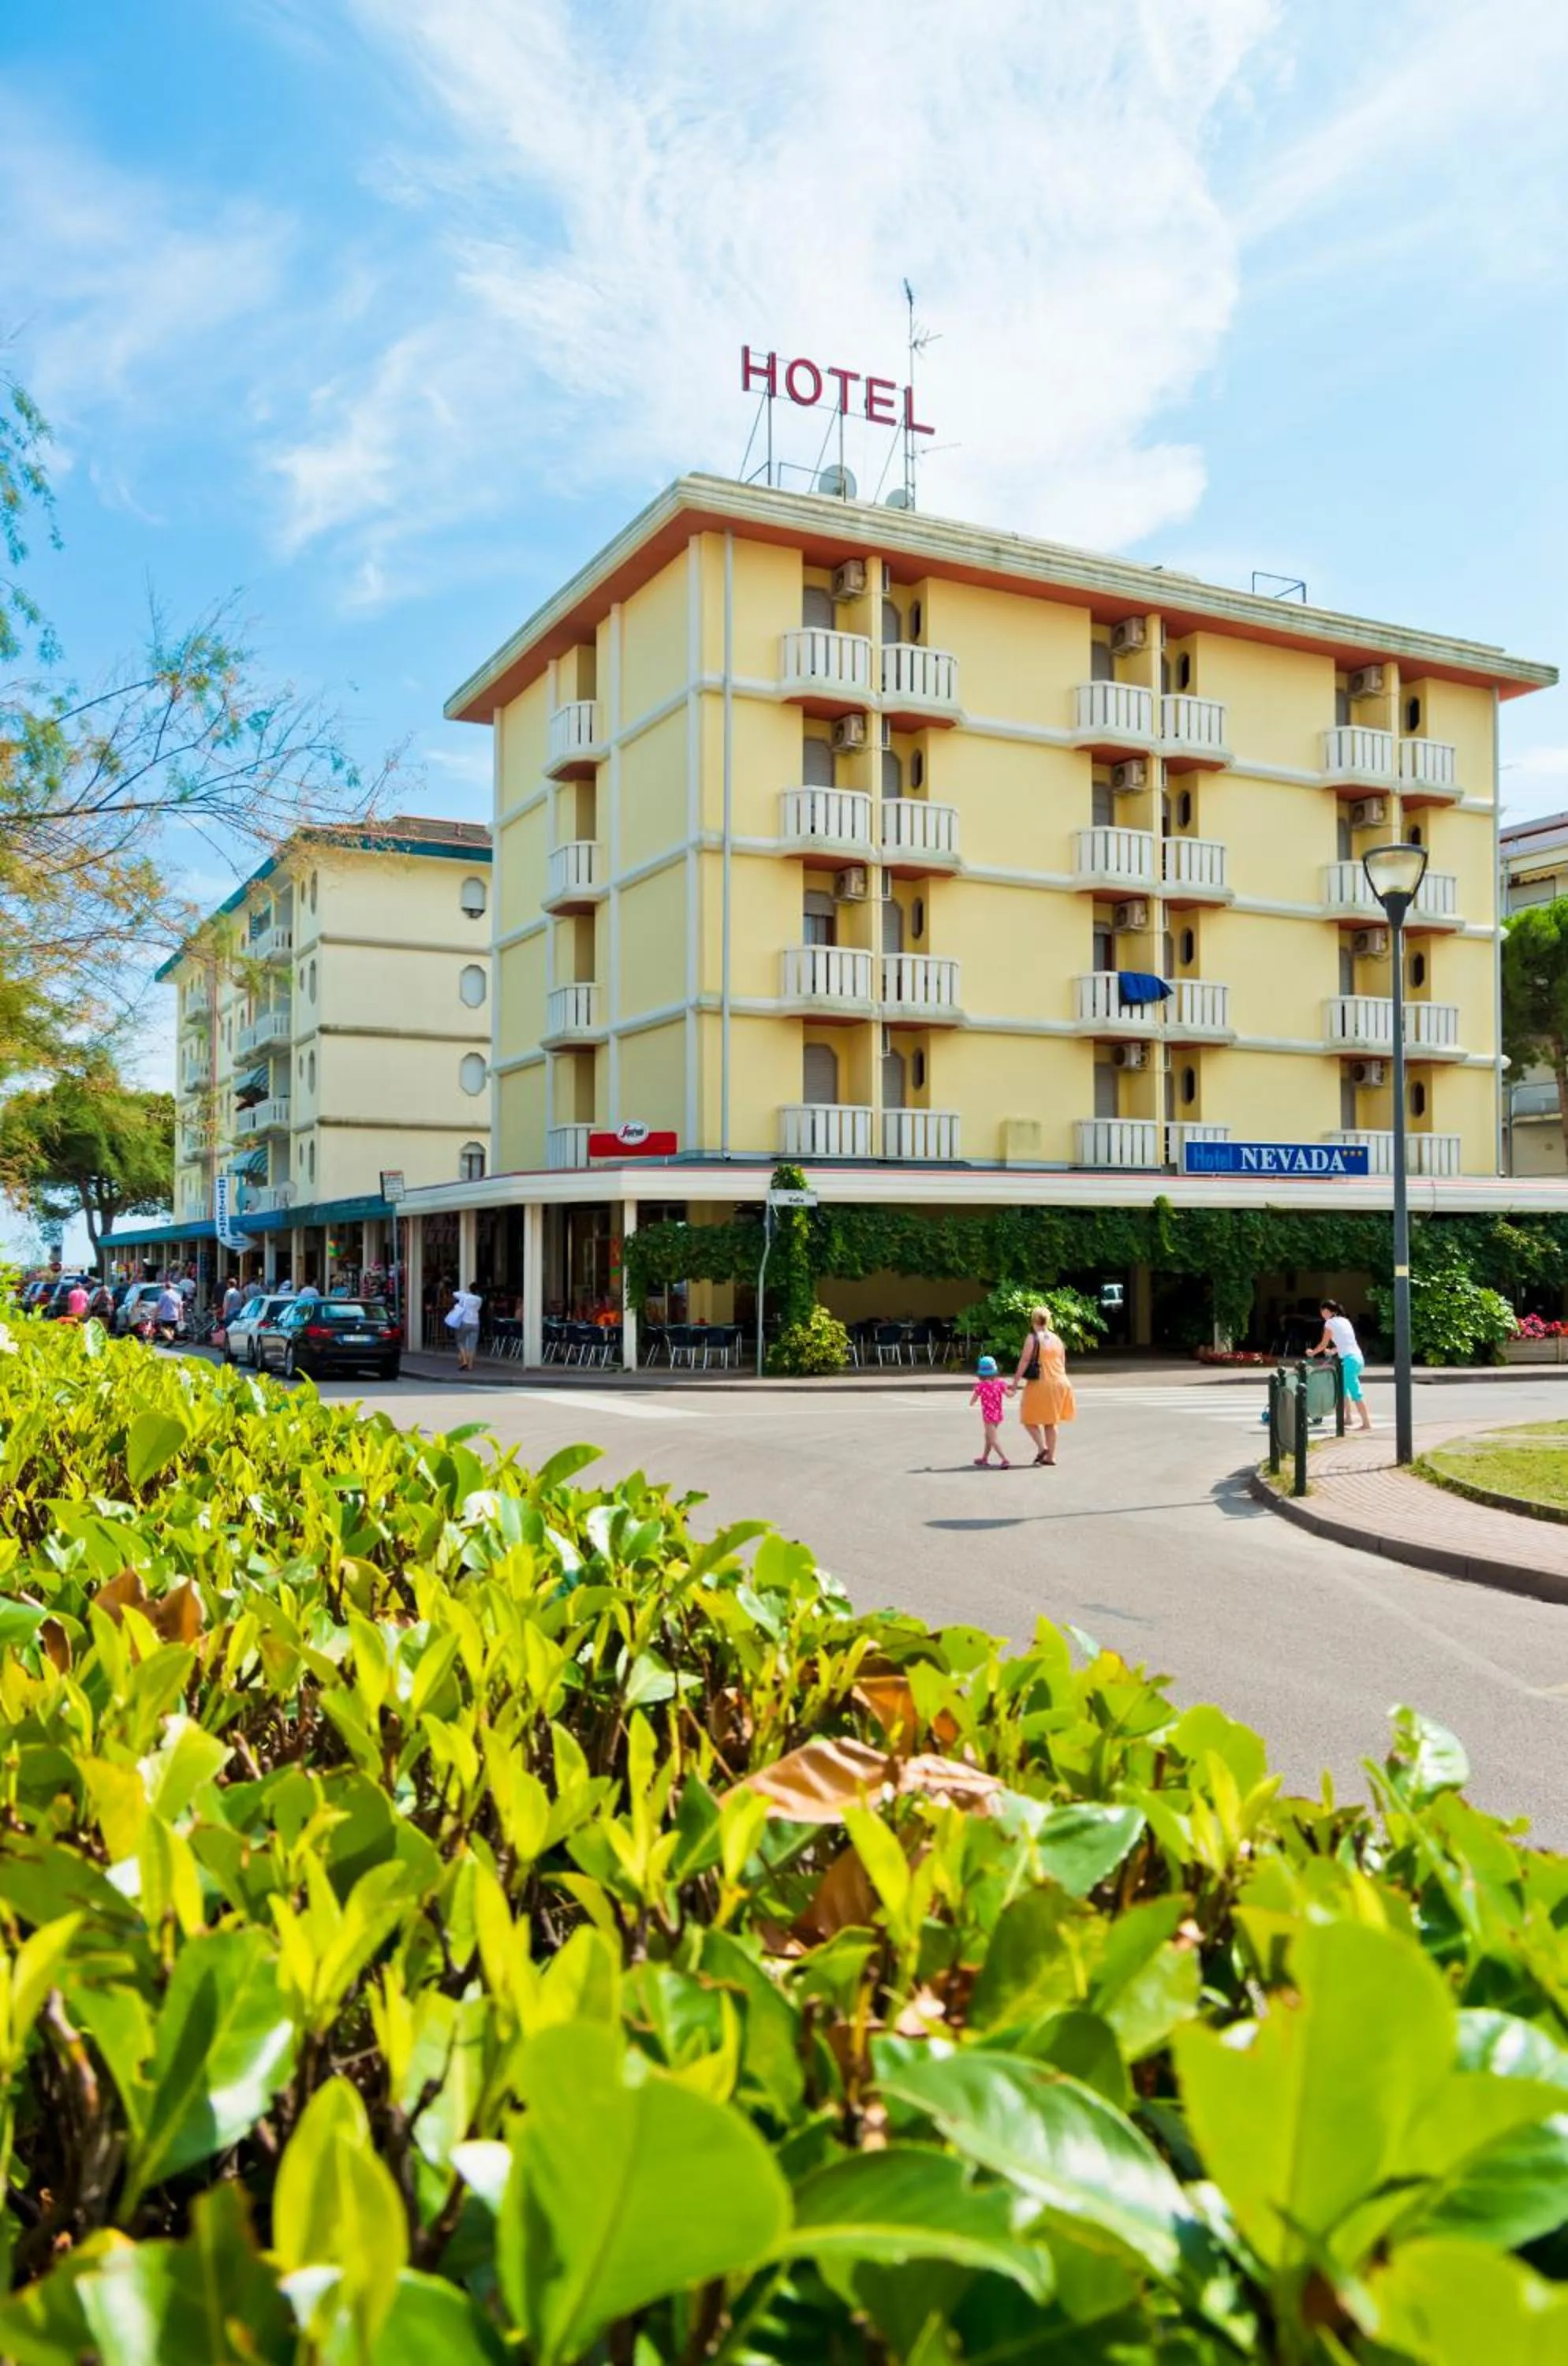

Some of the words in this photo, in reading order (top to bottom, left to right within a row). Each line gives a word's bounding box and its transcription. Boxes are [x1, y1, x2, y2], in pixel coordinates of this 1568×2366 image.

[741, 345, 935, 435] HOTEL
[1193, 1144, 1234, 1170] Hotel
[1240, 1147, 1346, 1172] NEVADA
